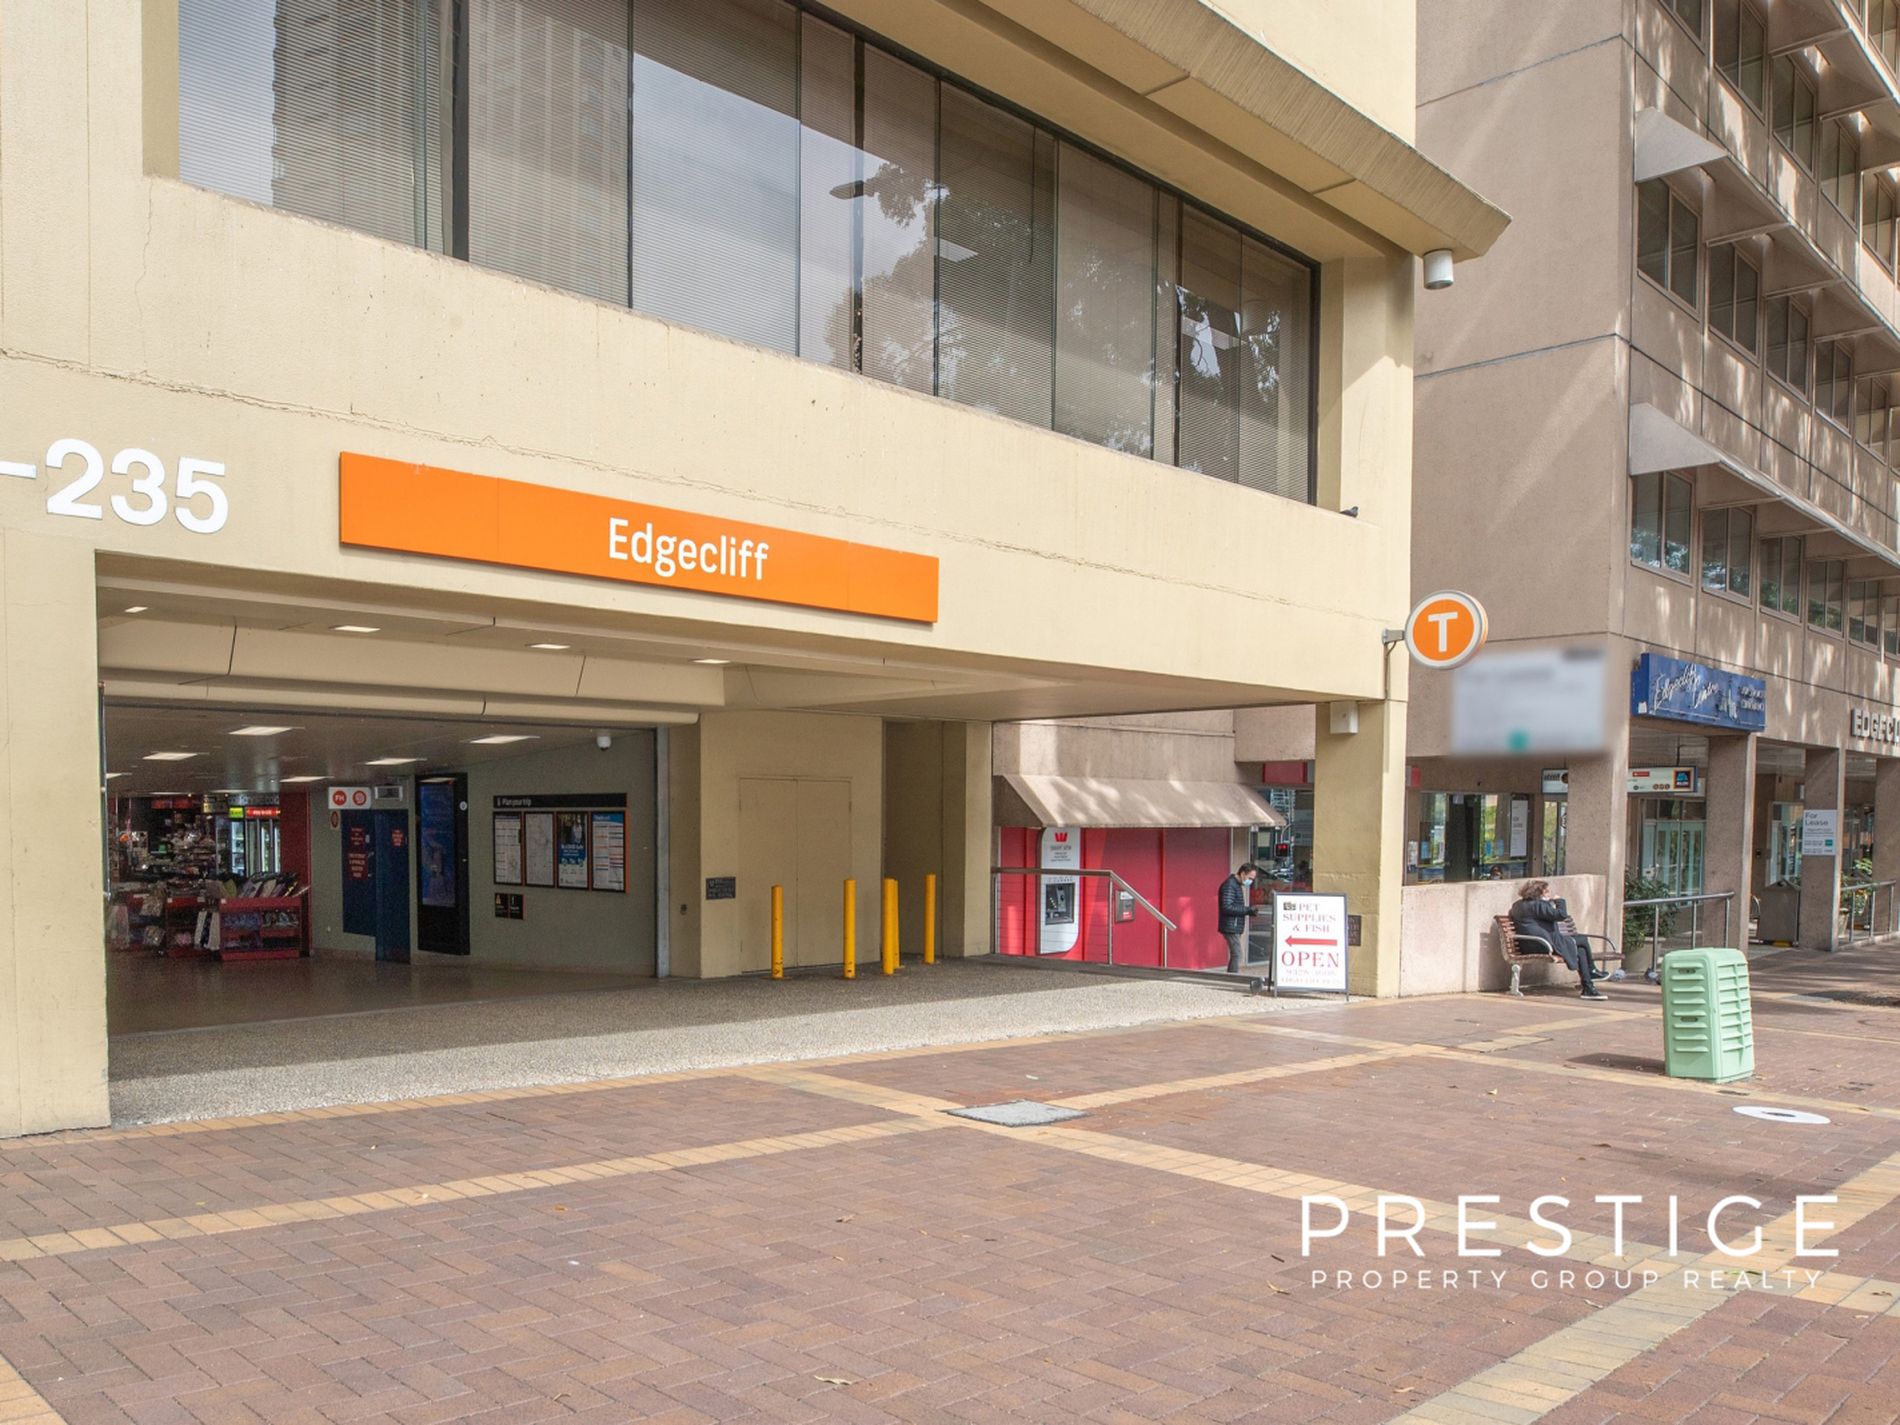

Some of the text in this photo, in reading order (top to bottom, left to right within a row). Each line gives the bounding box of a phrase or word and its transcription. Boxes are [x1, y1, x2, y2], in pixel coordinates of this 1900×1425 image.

[609, 517, 769, 580] Edgecliff
[1428, 611, 1458, 653] T
[1299, 903, 1320, 912] PET
[1282, 913, 1337, 923] SUPPLIES
[1305, 924, 1330, 933] FISH
[1281, 950, 1340, 968] OPEN
